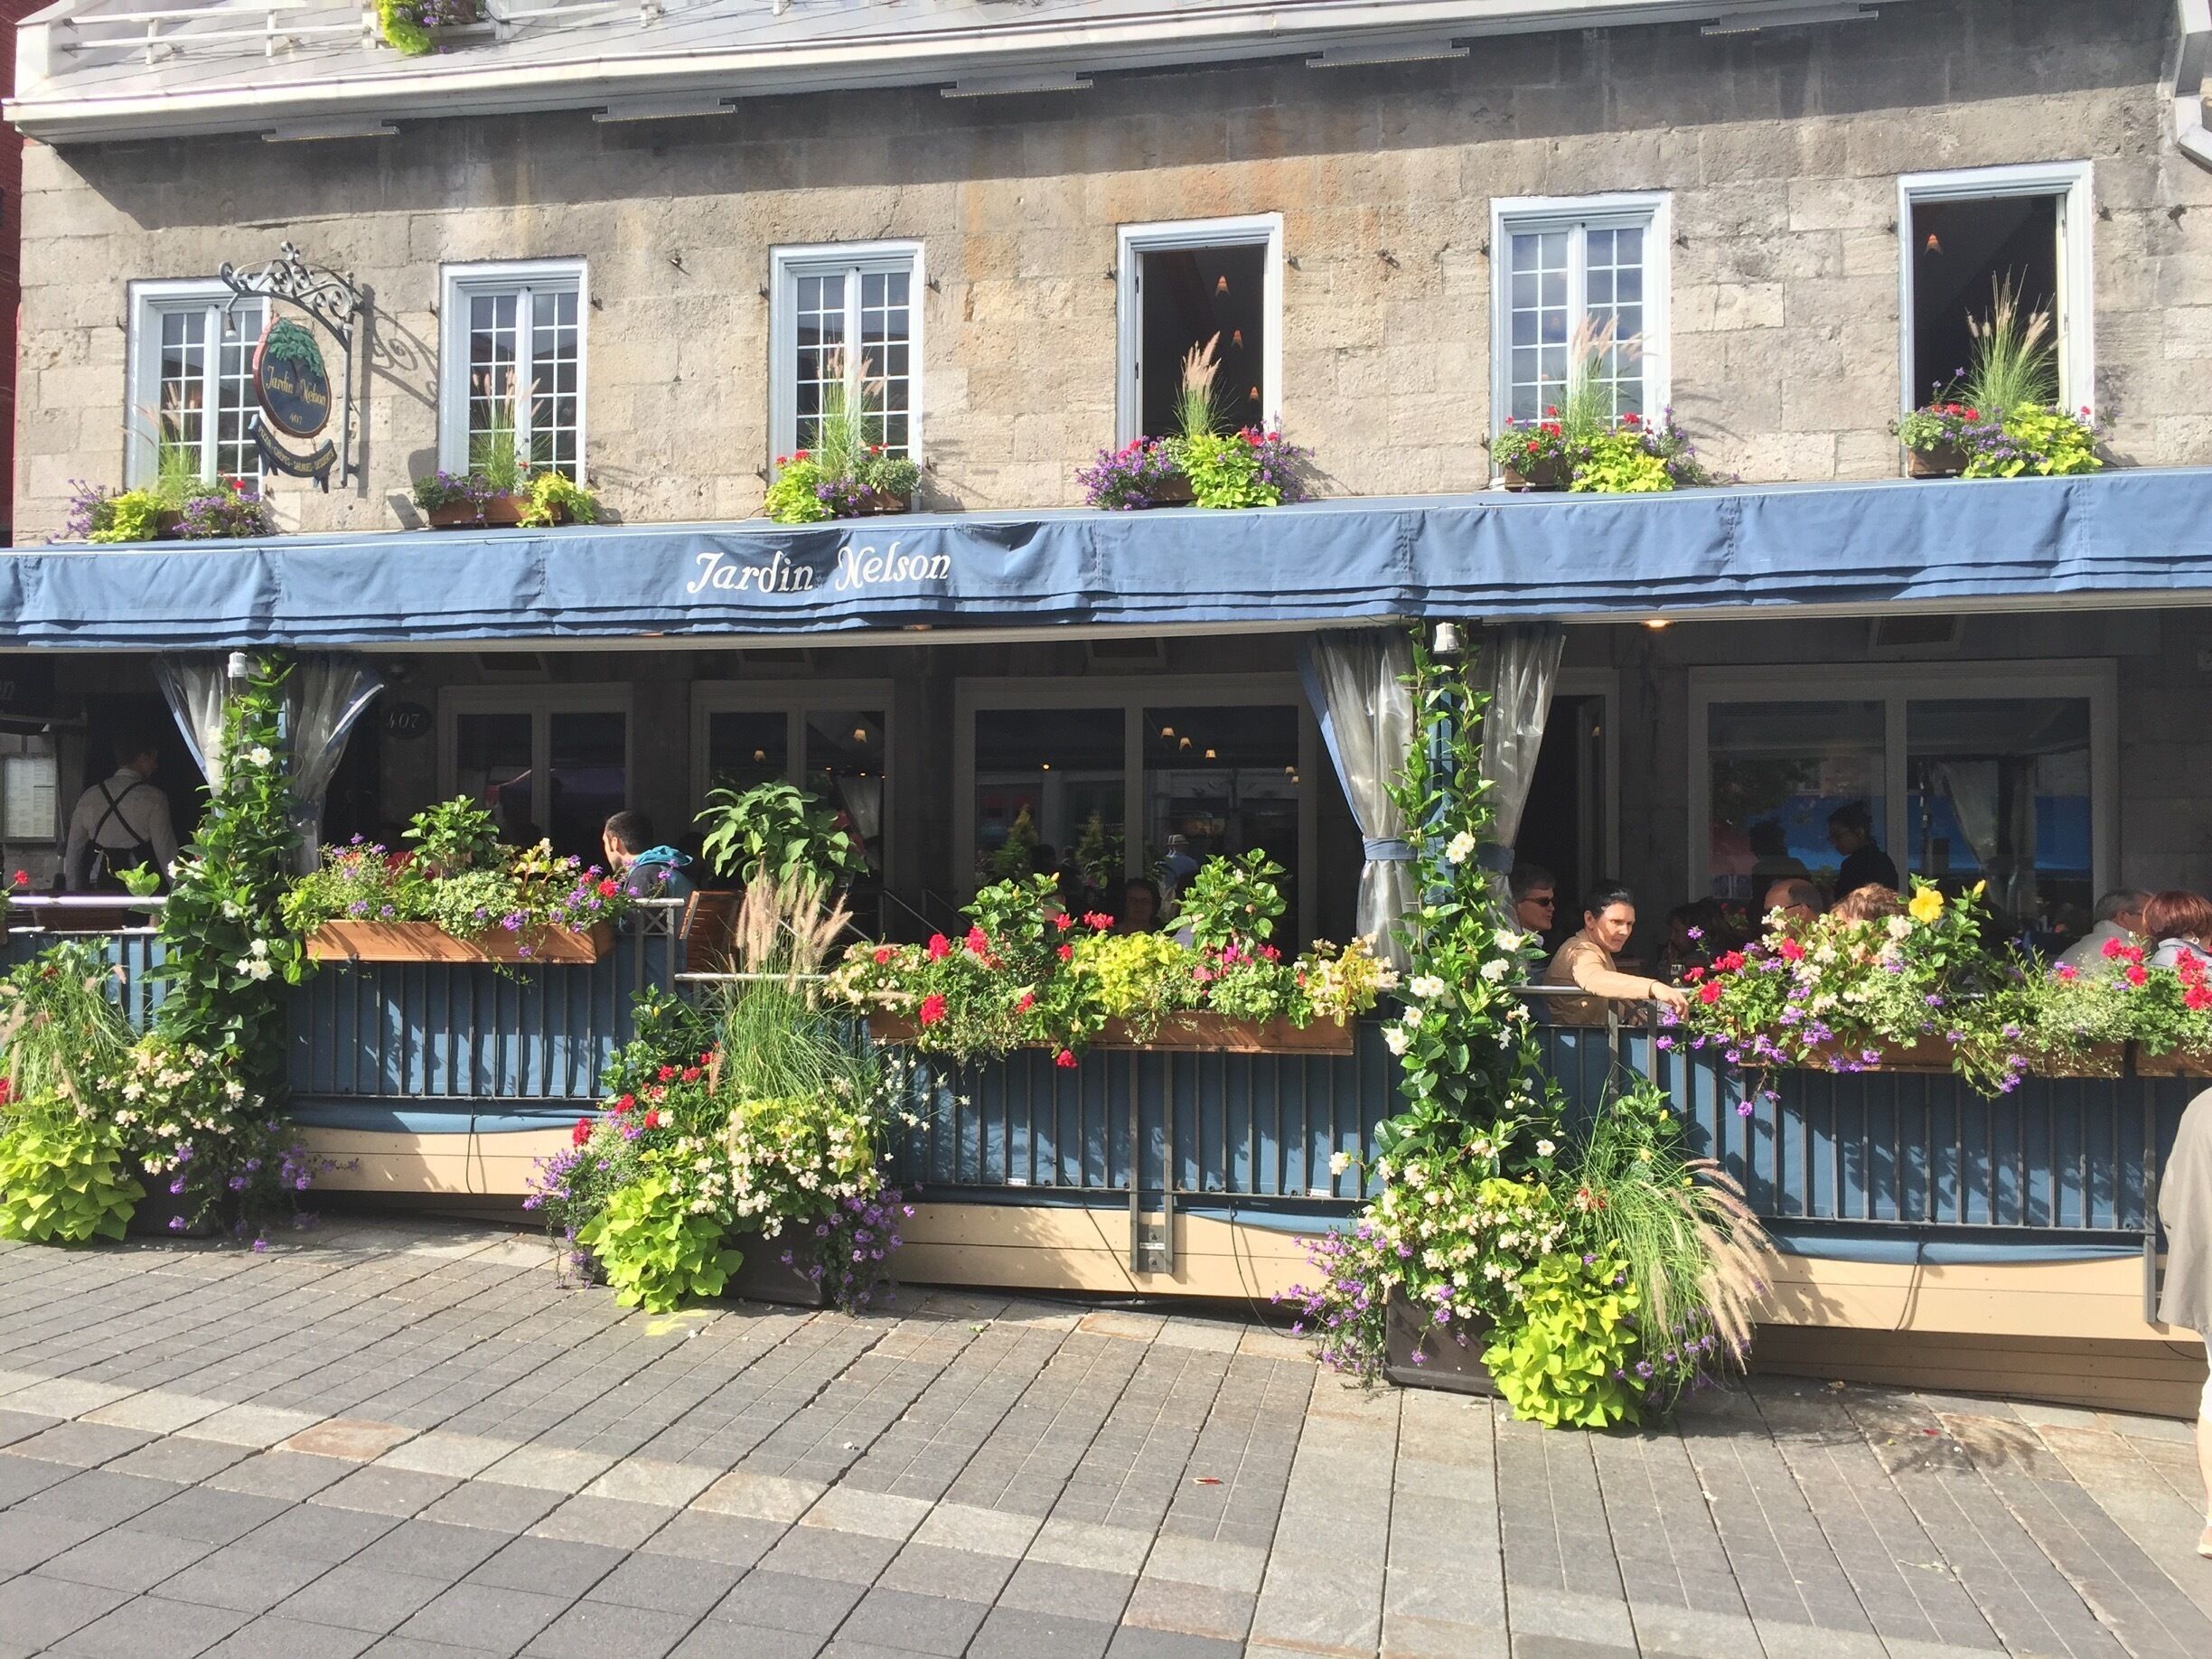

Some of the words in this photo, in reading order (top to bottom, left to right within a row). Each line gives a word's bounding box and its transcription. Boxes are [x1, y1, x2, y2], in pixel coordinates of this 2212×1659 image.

[266, 365, 294, 394] Jardin
[299, 379, 326, 406] Nelson
[289, 413, 303, 426] 407
[686, 550, 815, 595] Jardin
[835, 541, 951, 593] Nelson
[389, 712, 420, 729] 407
